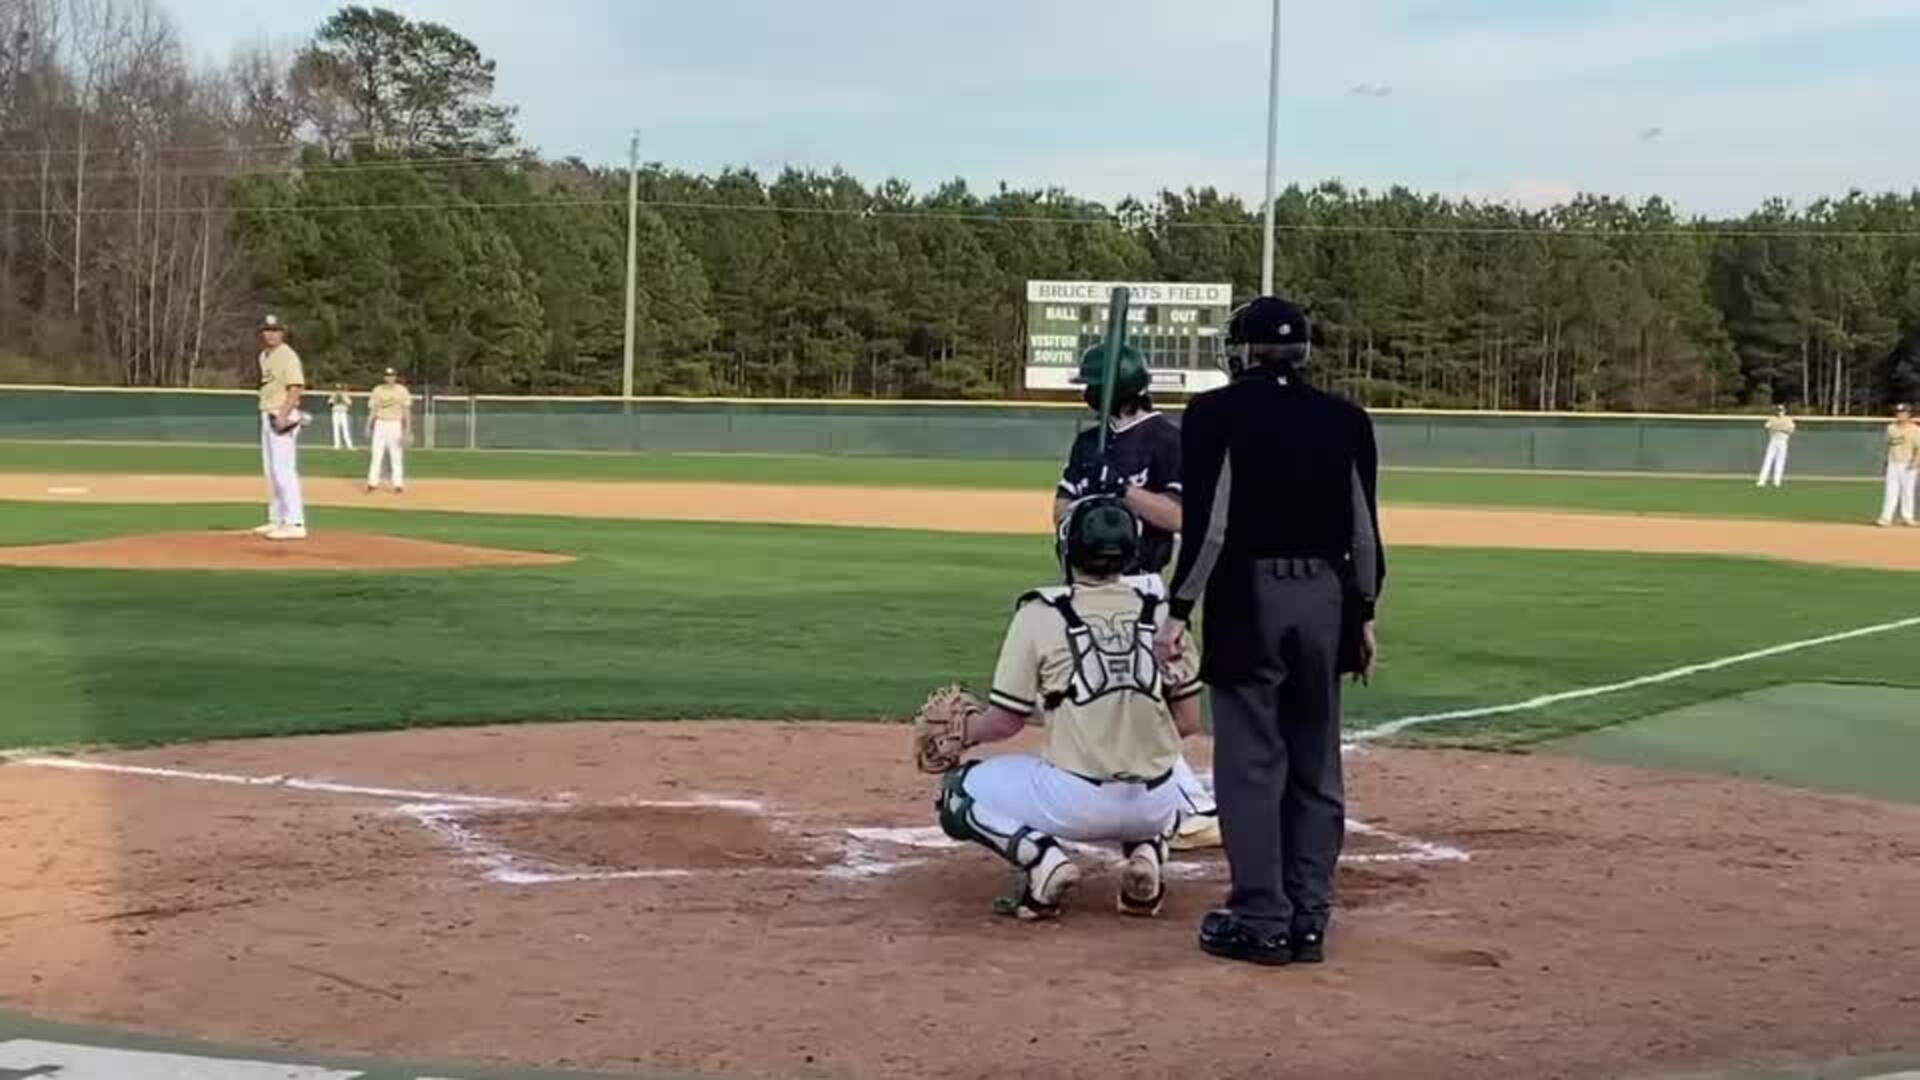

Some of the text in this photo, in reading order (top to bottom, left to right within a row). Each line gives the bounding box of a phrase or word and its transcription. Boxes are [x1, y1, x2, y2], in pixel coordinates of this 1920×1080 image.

[1039, 284, 1219, 300] BRUCE ATS FIELD
[1045, 306, 1080, 321] BALL
[1170, 309, 1198, 322] OUT
[1034, 350, 1073, 363] SOUTH
